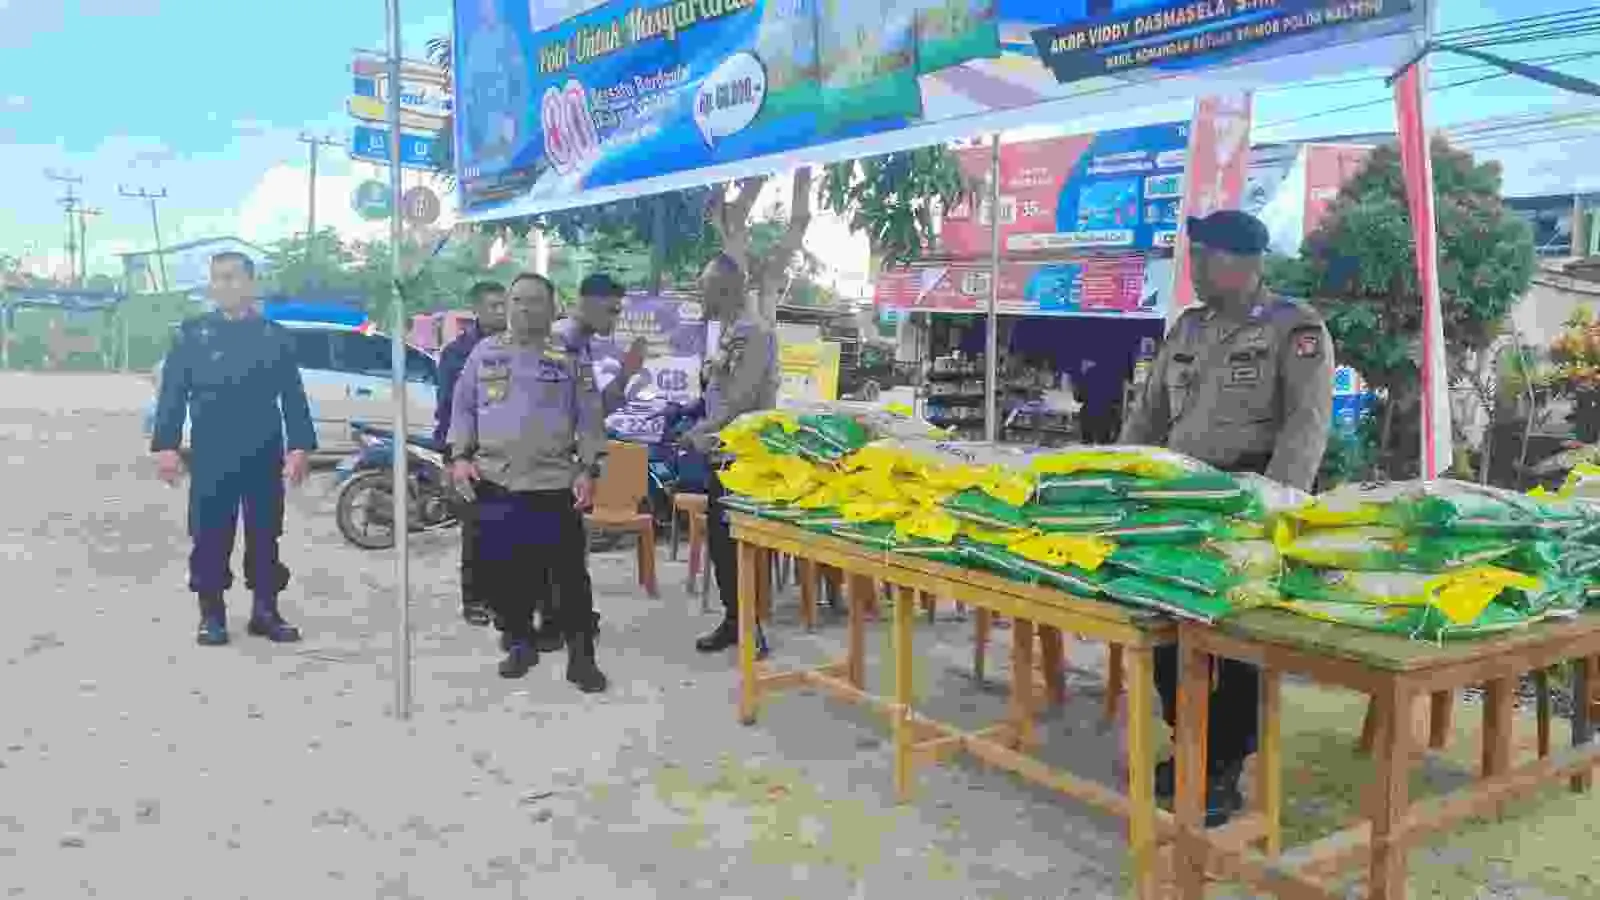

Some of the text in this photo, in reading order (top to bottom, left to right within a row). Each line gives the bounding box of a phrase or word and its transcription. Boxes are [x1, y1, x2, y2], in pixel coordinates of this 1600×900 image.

[575, 19, 619, 63] Untuk
[1088, 23, 1130, 47] VIDDY
[656, 369, 689, 391] GB
